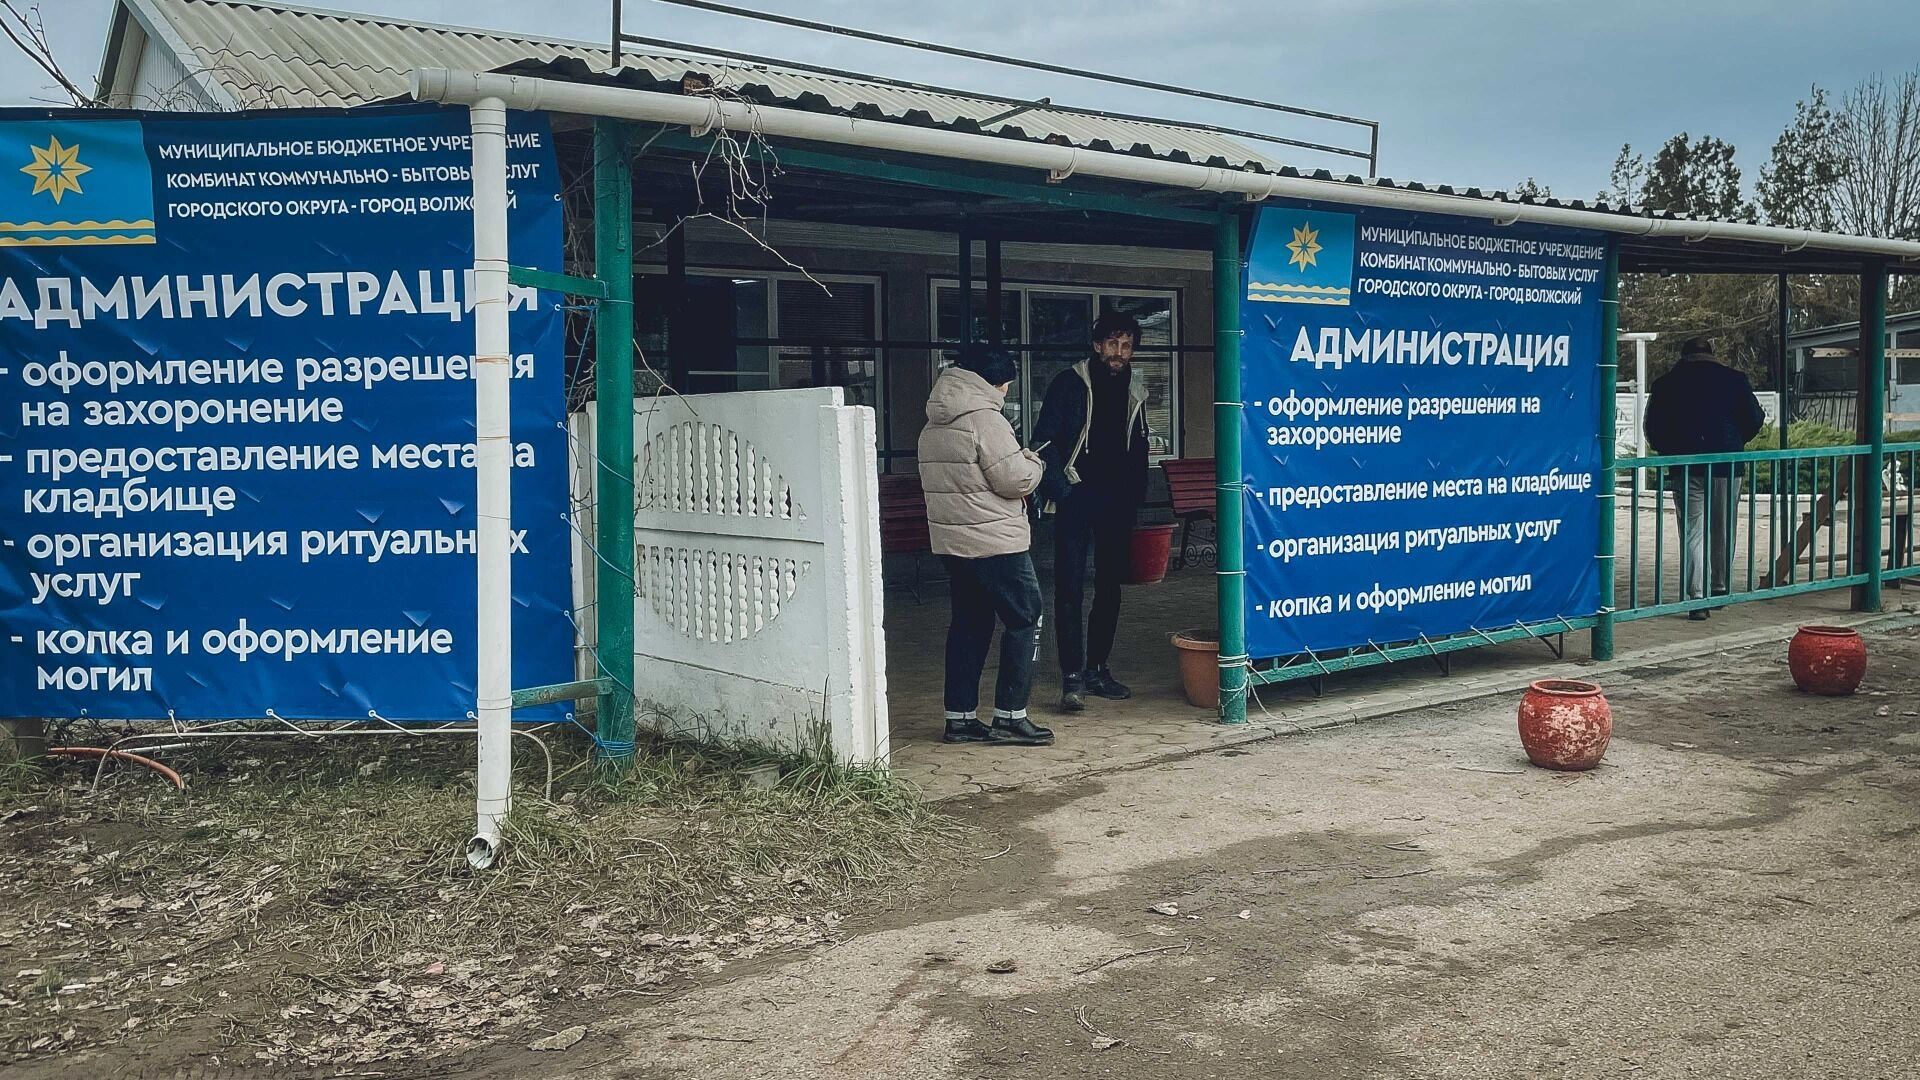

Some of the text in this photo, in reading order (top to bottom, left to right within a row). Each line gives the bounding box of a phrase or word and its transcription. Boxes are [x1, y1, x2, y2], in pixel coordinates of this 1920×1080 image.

[158, 133, 541, 161] МУНИЦИПАЛЬНОЕ БЮДЖЕТНОЕ УЧРЕНИЕ
[166, 172, 256, 189] КОМБИНАТ
[258, 168, 390, 186] КОММУНАЛЬНО
[401, 165, 473, 183] БЫТОВЫ
[168, 200, 283, 220] ГОРОДСКОГО
[285, 199, 350, 216] ОКРУГА
[360, 197, 417, 215] ГОРОД
[419, 189, 517, 212] ВОЛЖЙ
[1361, 225, 1604, 261] МУНИЦИПАЛЬНОЕ БЮДЖЕТНОЕ УЧРЕЖДЕНИЕ
[1360, 251, 1427, 271] КОМБИНАТ
[1427, 257, 1512, 277] КОММУНАЛЬНО
[1518, 263, 1567, 281] БЫТОВЫХ
[1568, 267, 1600, 283] УСЛУГ
[1357, 278, 1441, 298] ГОРОДСКОГО
[1441, 283, 1483, 300] ОКРУГА
[1489, 285, 1524, 305] ГОРОД
[1525, 286, 1582, 305] ВОЛЖСКИЙ
[1289, 325, 1570, 373] АДМИНИСТРАЦИЯ
[22, 350, 284, 394] оформление
[296, 353, 534, 391] разрешея
[21, 397, 344, 431] на захоронение
[1268, 388, 1403, 422] оформление
[1407, 397, 1517, 421] разрешения
[1521, 396, 1541, 414] на
[1267, 425, 1402, 451] захоронение
[27, 444, 360, 481] предоставление
[371, 443, 478, 469] места
[511, 442, 535, 468] а
[24, 474, 236, 519] кладбище
[1269, 481, 1428, 512] предоставление
[1432, 478, 1483, 498] места
[1487, 476, 1508, 495] на
[1511, 467, 1592, 496] кладбище
[27, 530, 288, 566] организация
[301, 529, 530, 563] ритуальнх
[1268, 531, 1400, 563] организация
[1405, 522, 1512, 554] ритуальных
[1514, 518, 1562, 544] услуг
[30, 572, 141, 606] услуг
[1269, 595, 1332, 619] копка
[1338, 593, 1351, 613] и
[1356, 580, 1476, 614] оформление
[1479, 574, 1532, 596] могил
[37, 629, 153, 655] копка
[166, 629, 189, 655] и
[202, 617, 453, 662] оформление
[37, 665, 153, 692] могил
